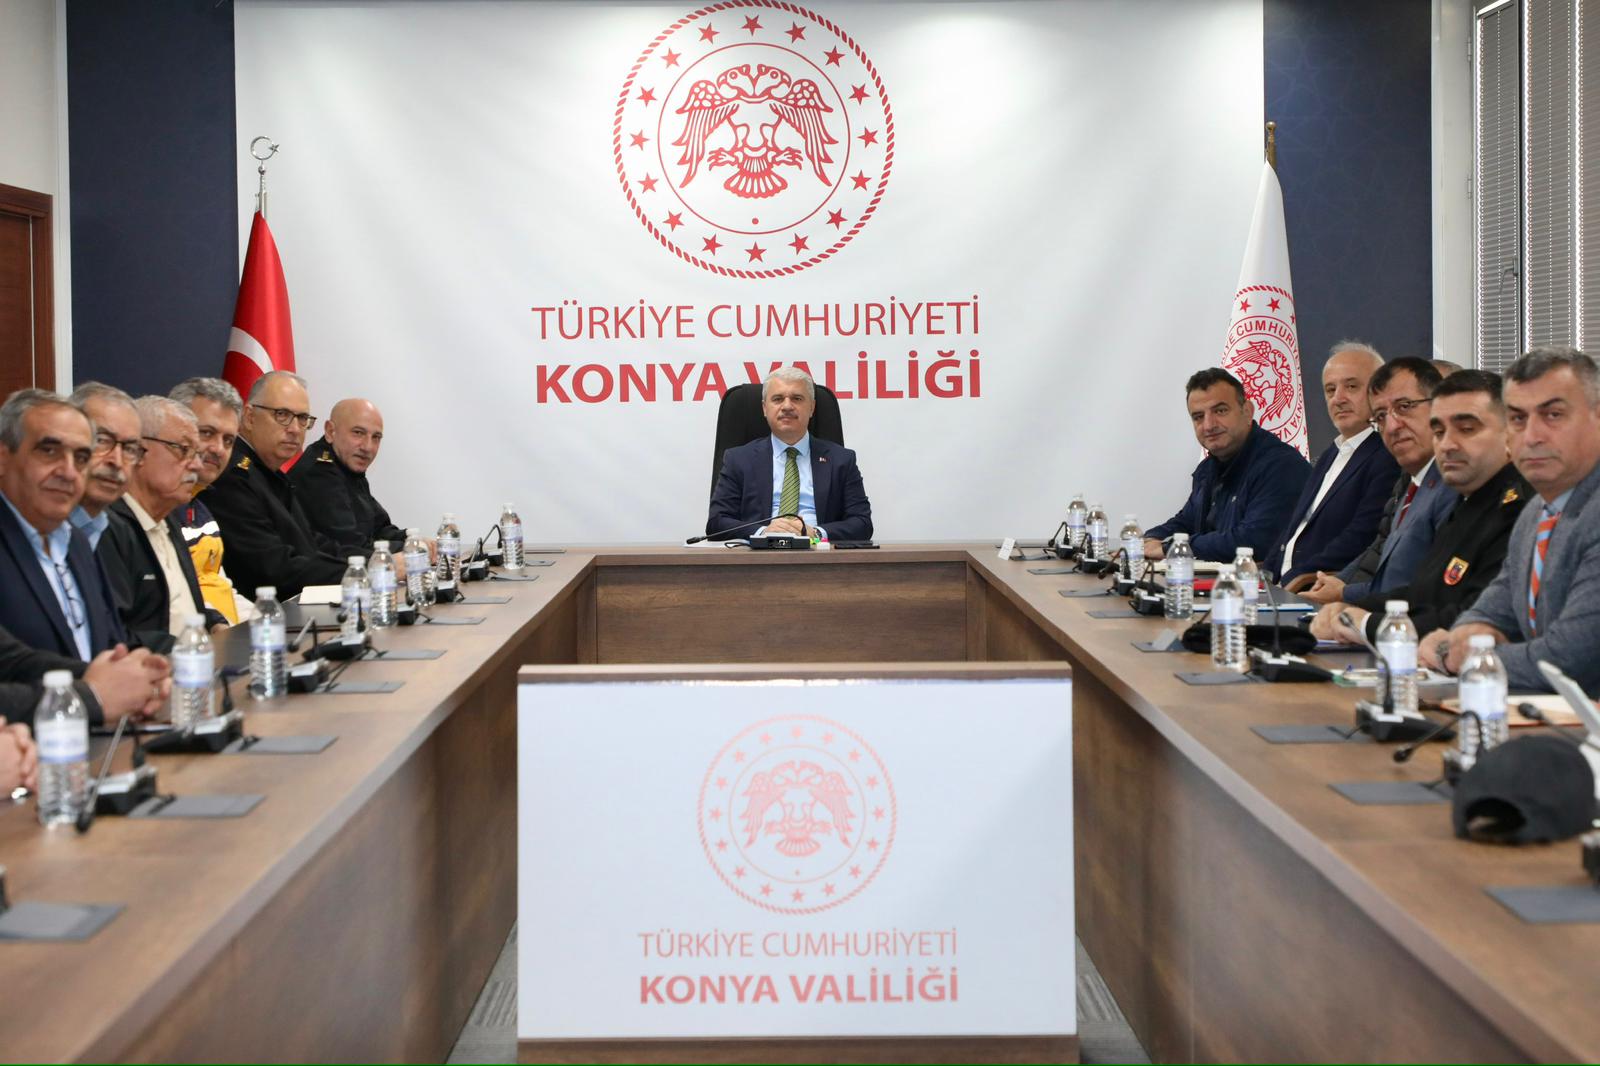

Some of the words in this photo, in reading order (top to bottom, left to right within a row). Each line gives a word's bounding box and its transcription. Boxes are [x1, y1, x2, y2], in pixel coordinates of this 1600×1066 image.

[532, 299, 695, 340] TÜRKİYE
[707, 295, 980, 338] CUMHURİYETİ
[536, 362, 728, 404] KONYA
[743, 349, 982, 400] LİLİĞİ
[637, 927, 753, 959] TÜRKİYE
[762, 926, 958, 958] CUMHURİYETİ
[640, 974, 780, 1005] KONYA
[789, 966, 959, 1003] VALİLİĞİ
